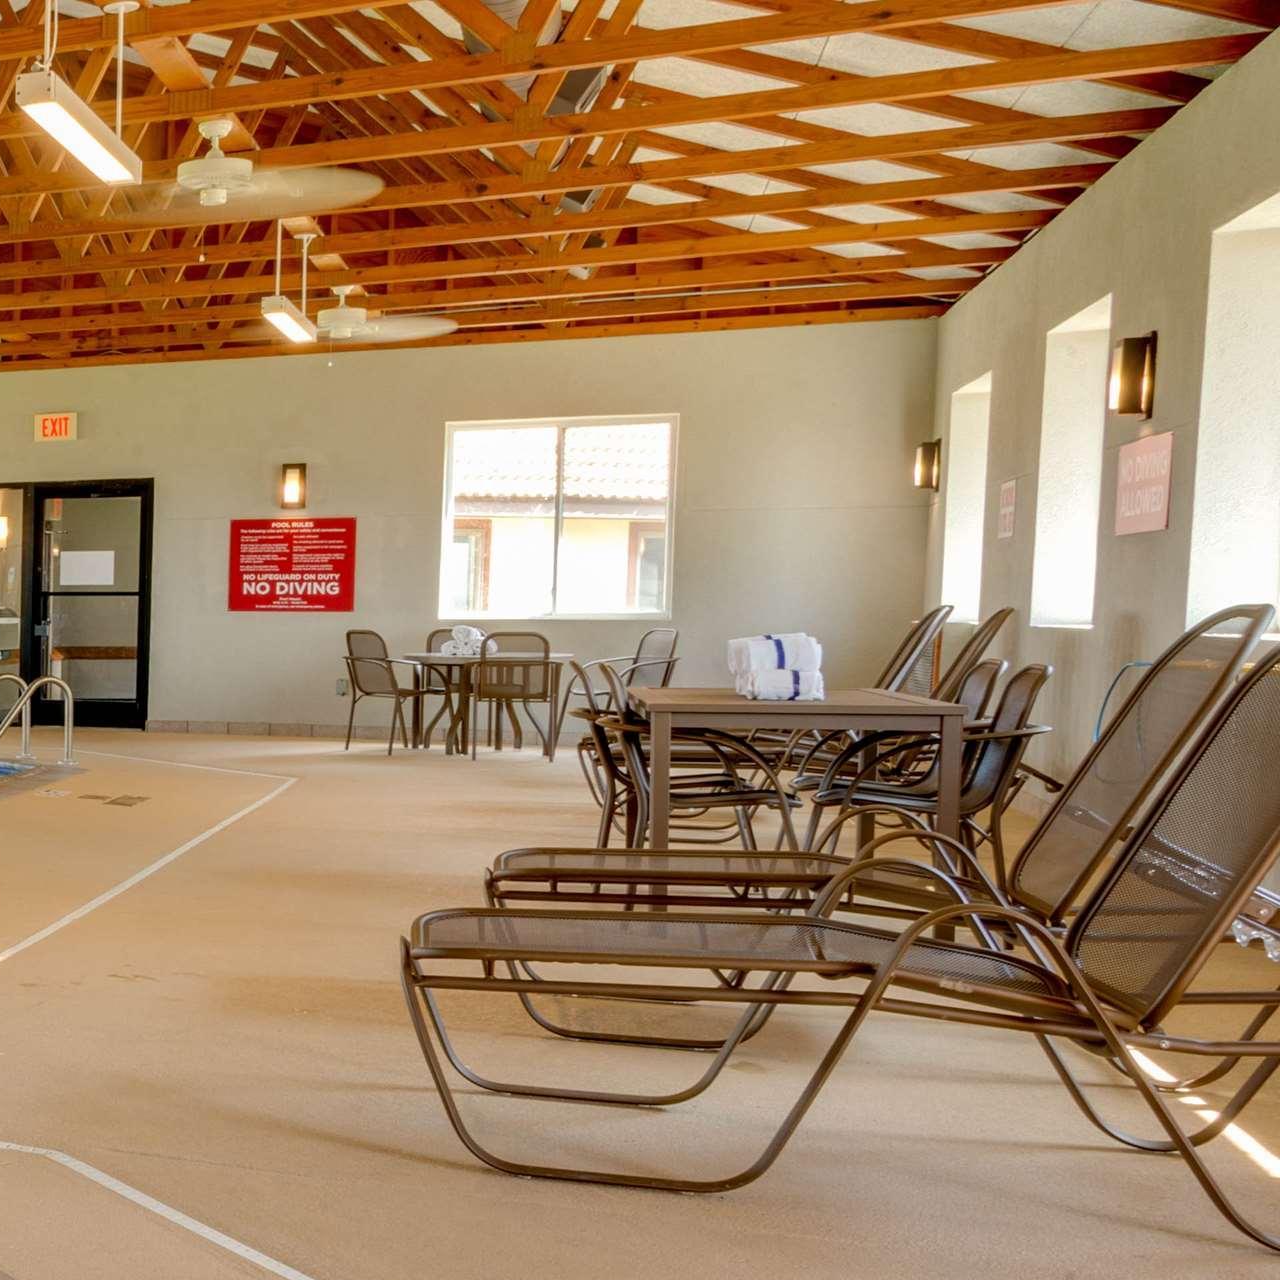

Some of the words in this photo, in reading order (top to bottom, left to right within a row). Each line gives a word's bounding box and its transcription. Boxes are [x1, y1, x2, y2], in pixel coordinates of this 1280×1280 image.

[42, 417, 69, 437] EXIT
[271, 521, 291, 529] POOL
[291, 520, 315, 528] RULES
[257, 573, 302, 581] LIFEGUARD
[242, 581, 271, 595] NO
[275, 581, 340, 595] DIVING
